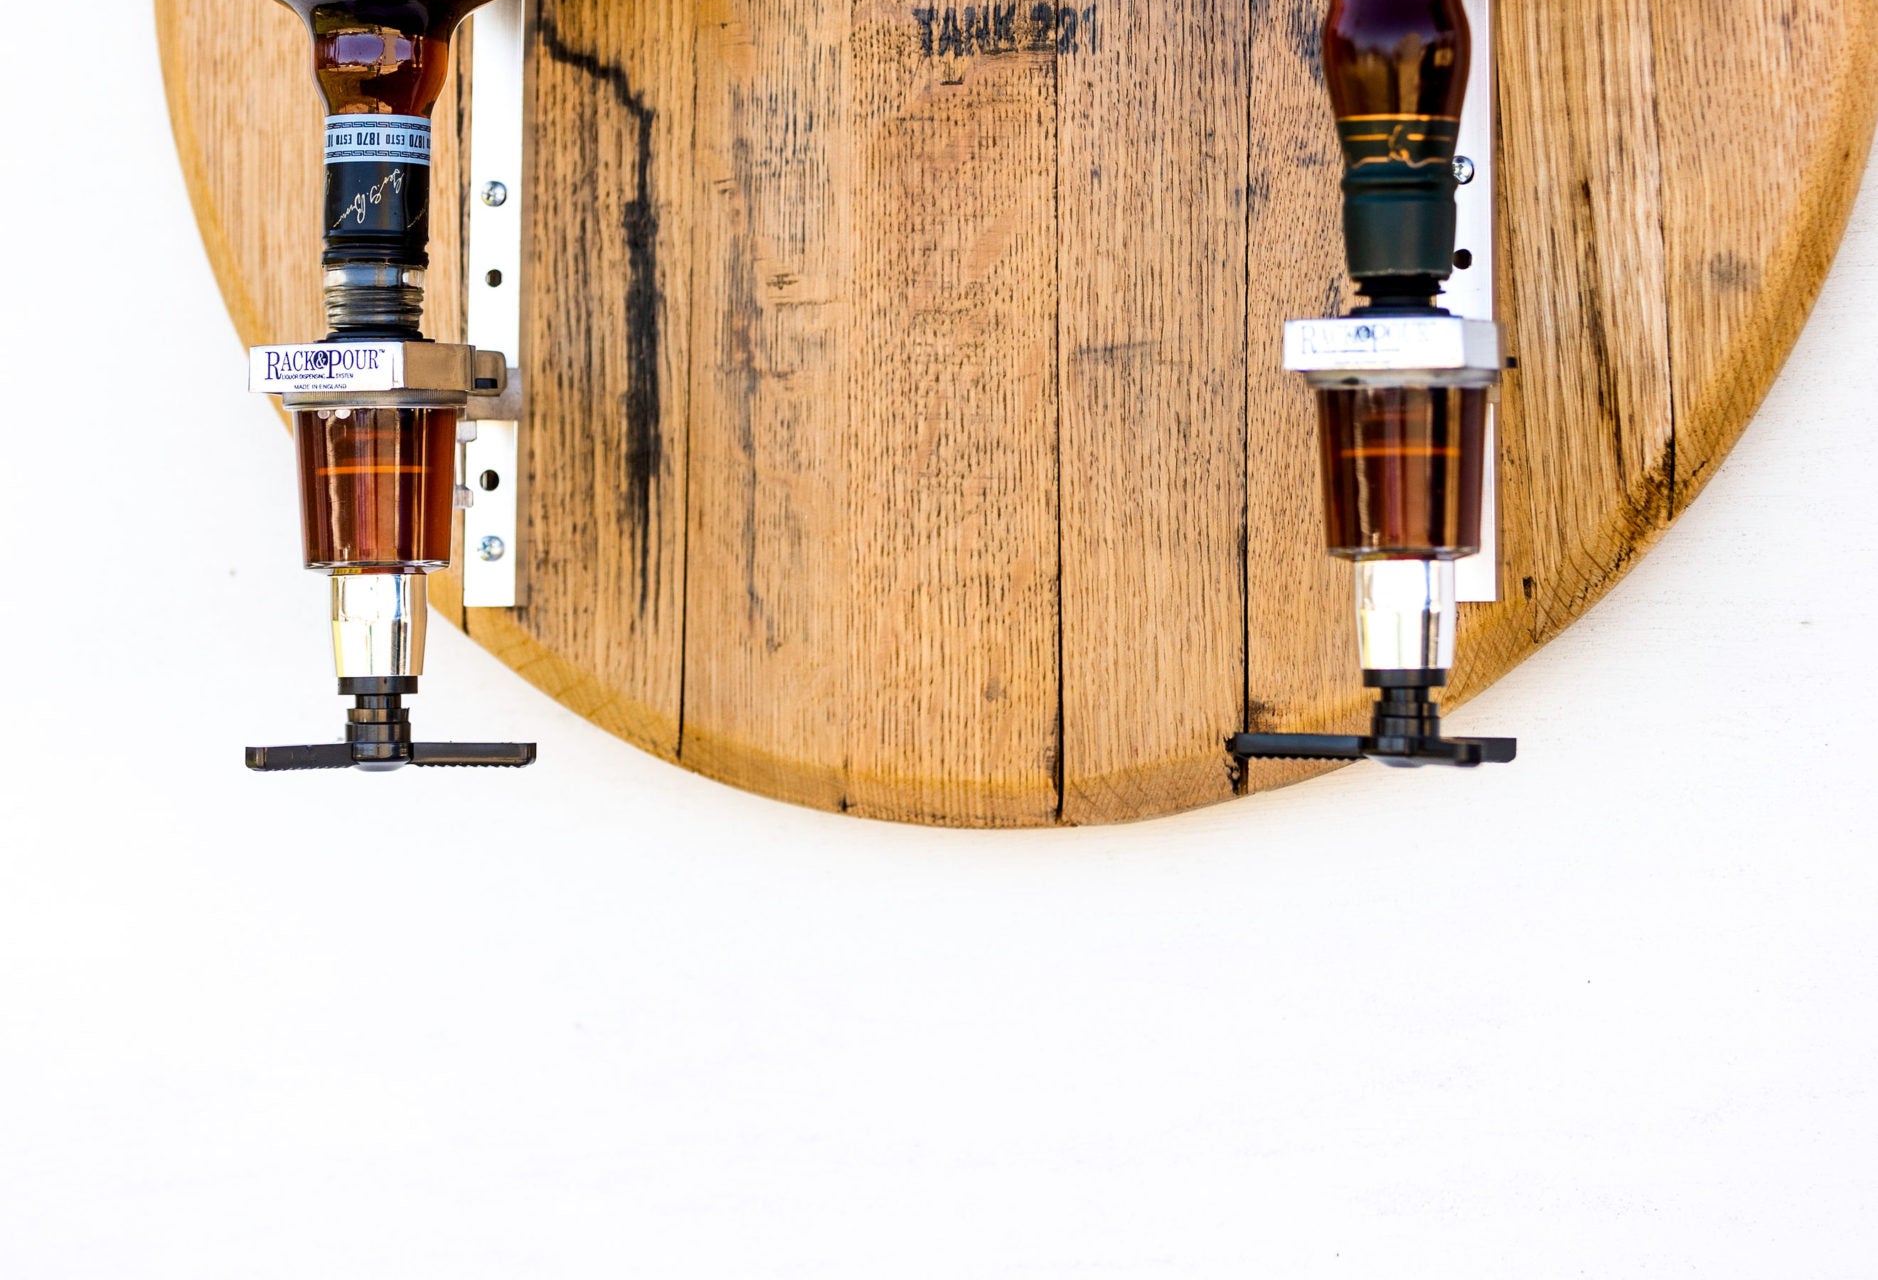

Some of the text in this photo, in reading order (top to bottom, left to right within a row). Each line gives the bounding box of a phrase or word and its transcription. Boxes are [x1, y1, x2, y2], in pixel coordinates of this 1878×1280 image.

[913, 4, 1017, 57] TANK
[357, 132, 380, 145] 1870
[409, 135, 425, 148] 1870
